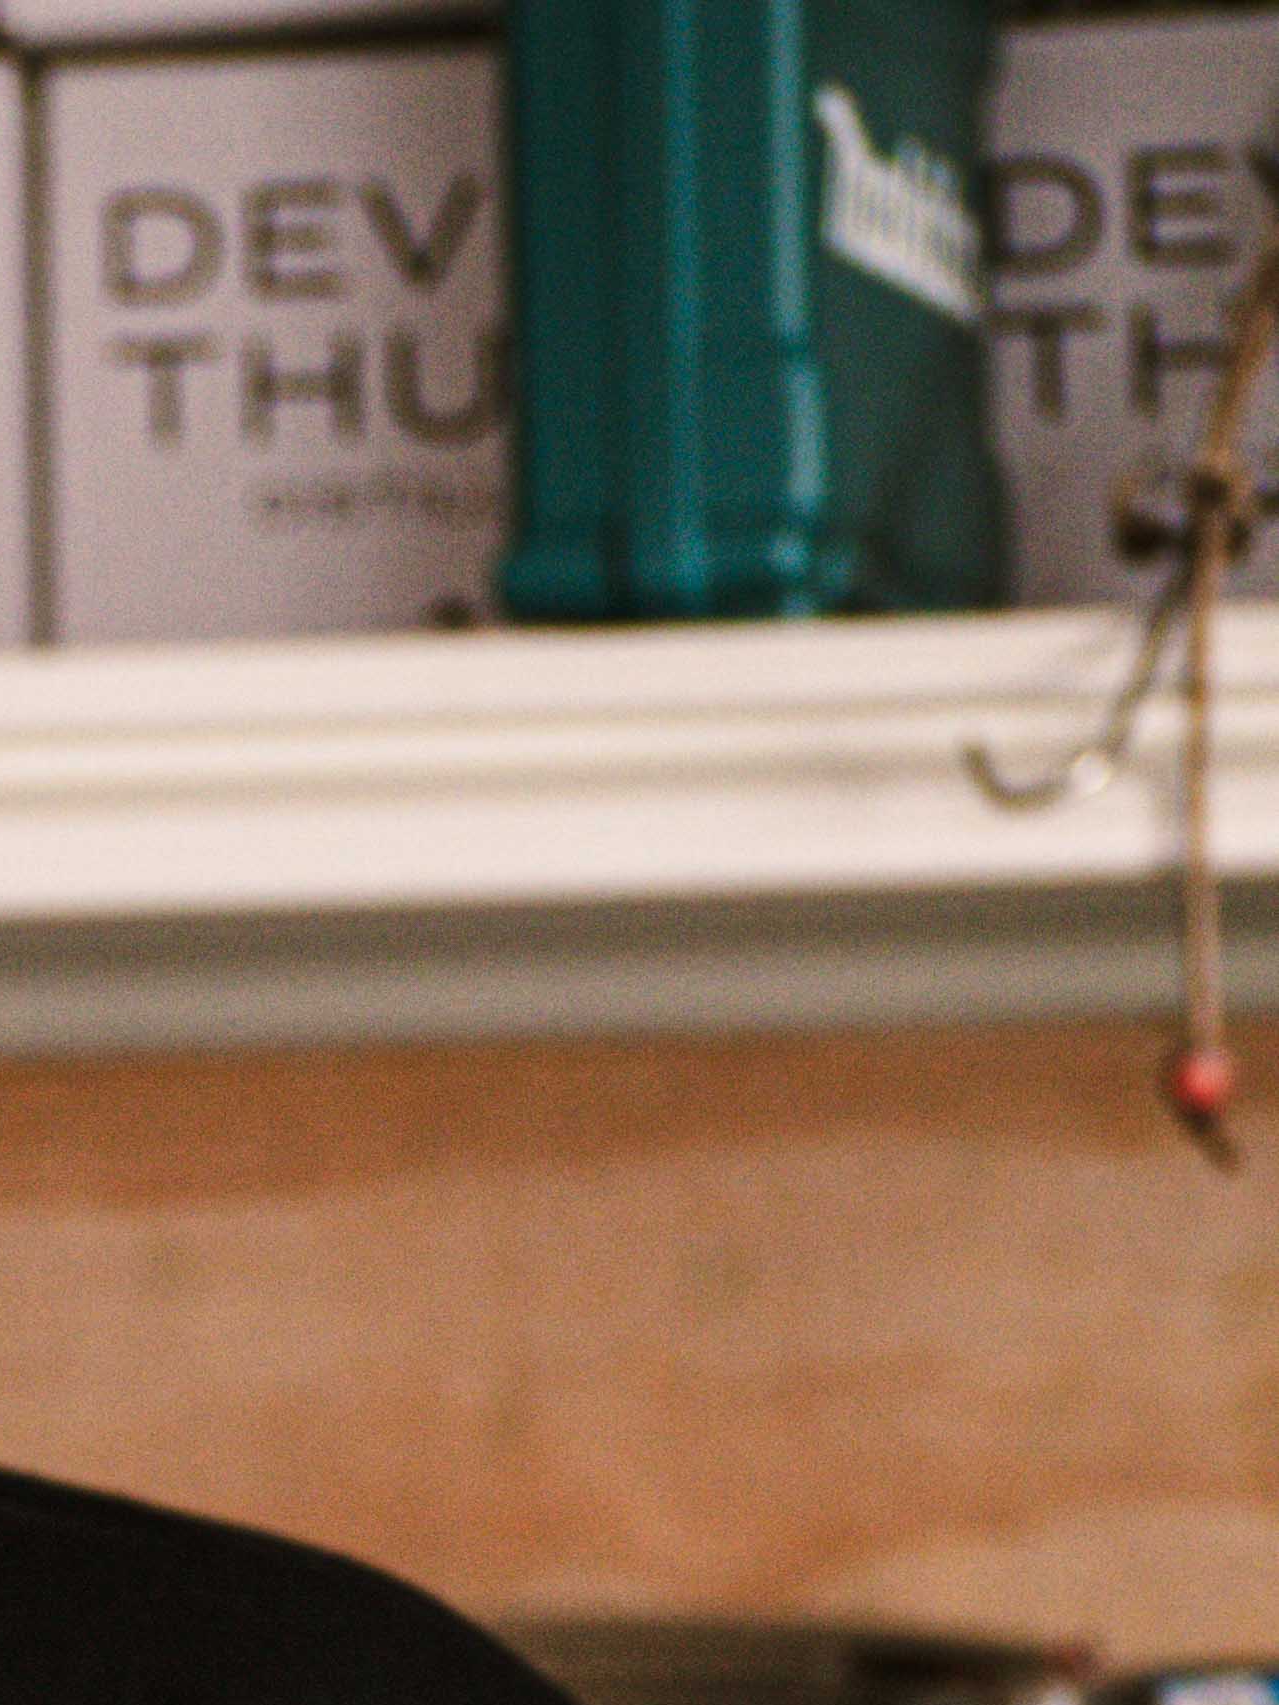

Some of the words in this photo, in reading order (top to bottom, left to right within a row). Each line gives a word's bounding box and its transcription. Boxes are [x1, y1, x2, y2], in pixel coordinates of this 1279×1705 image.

[103, 178, 483, 302] DEV
[993, 150, 1279, 275] DE
[106, 330, 511, 446] THU
